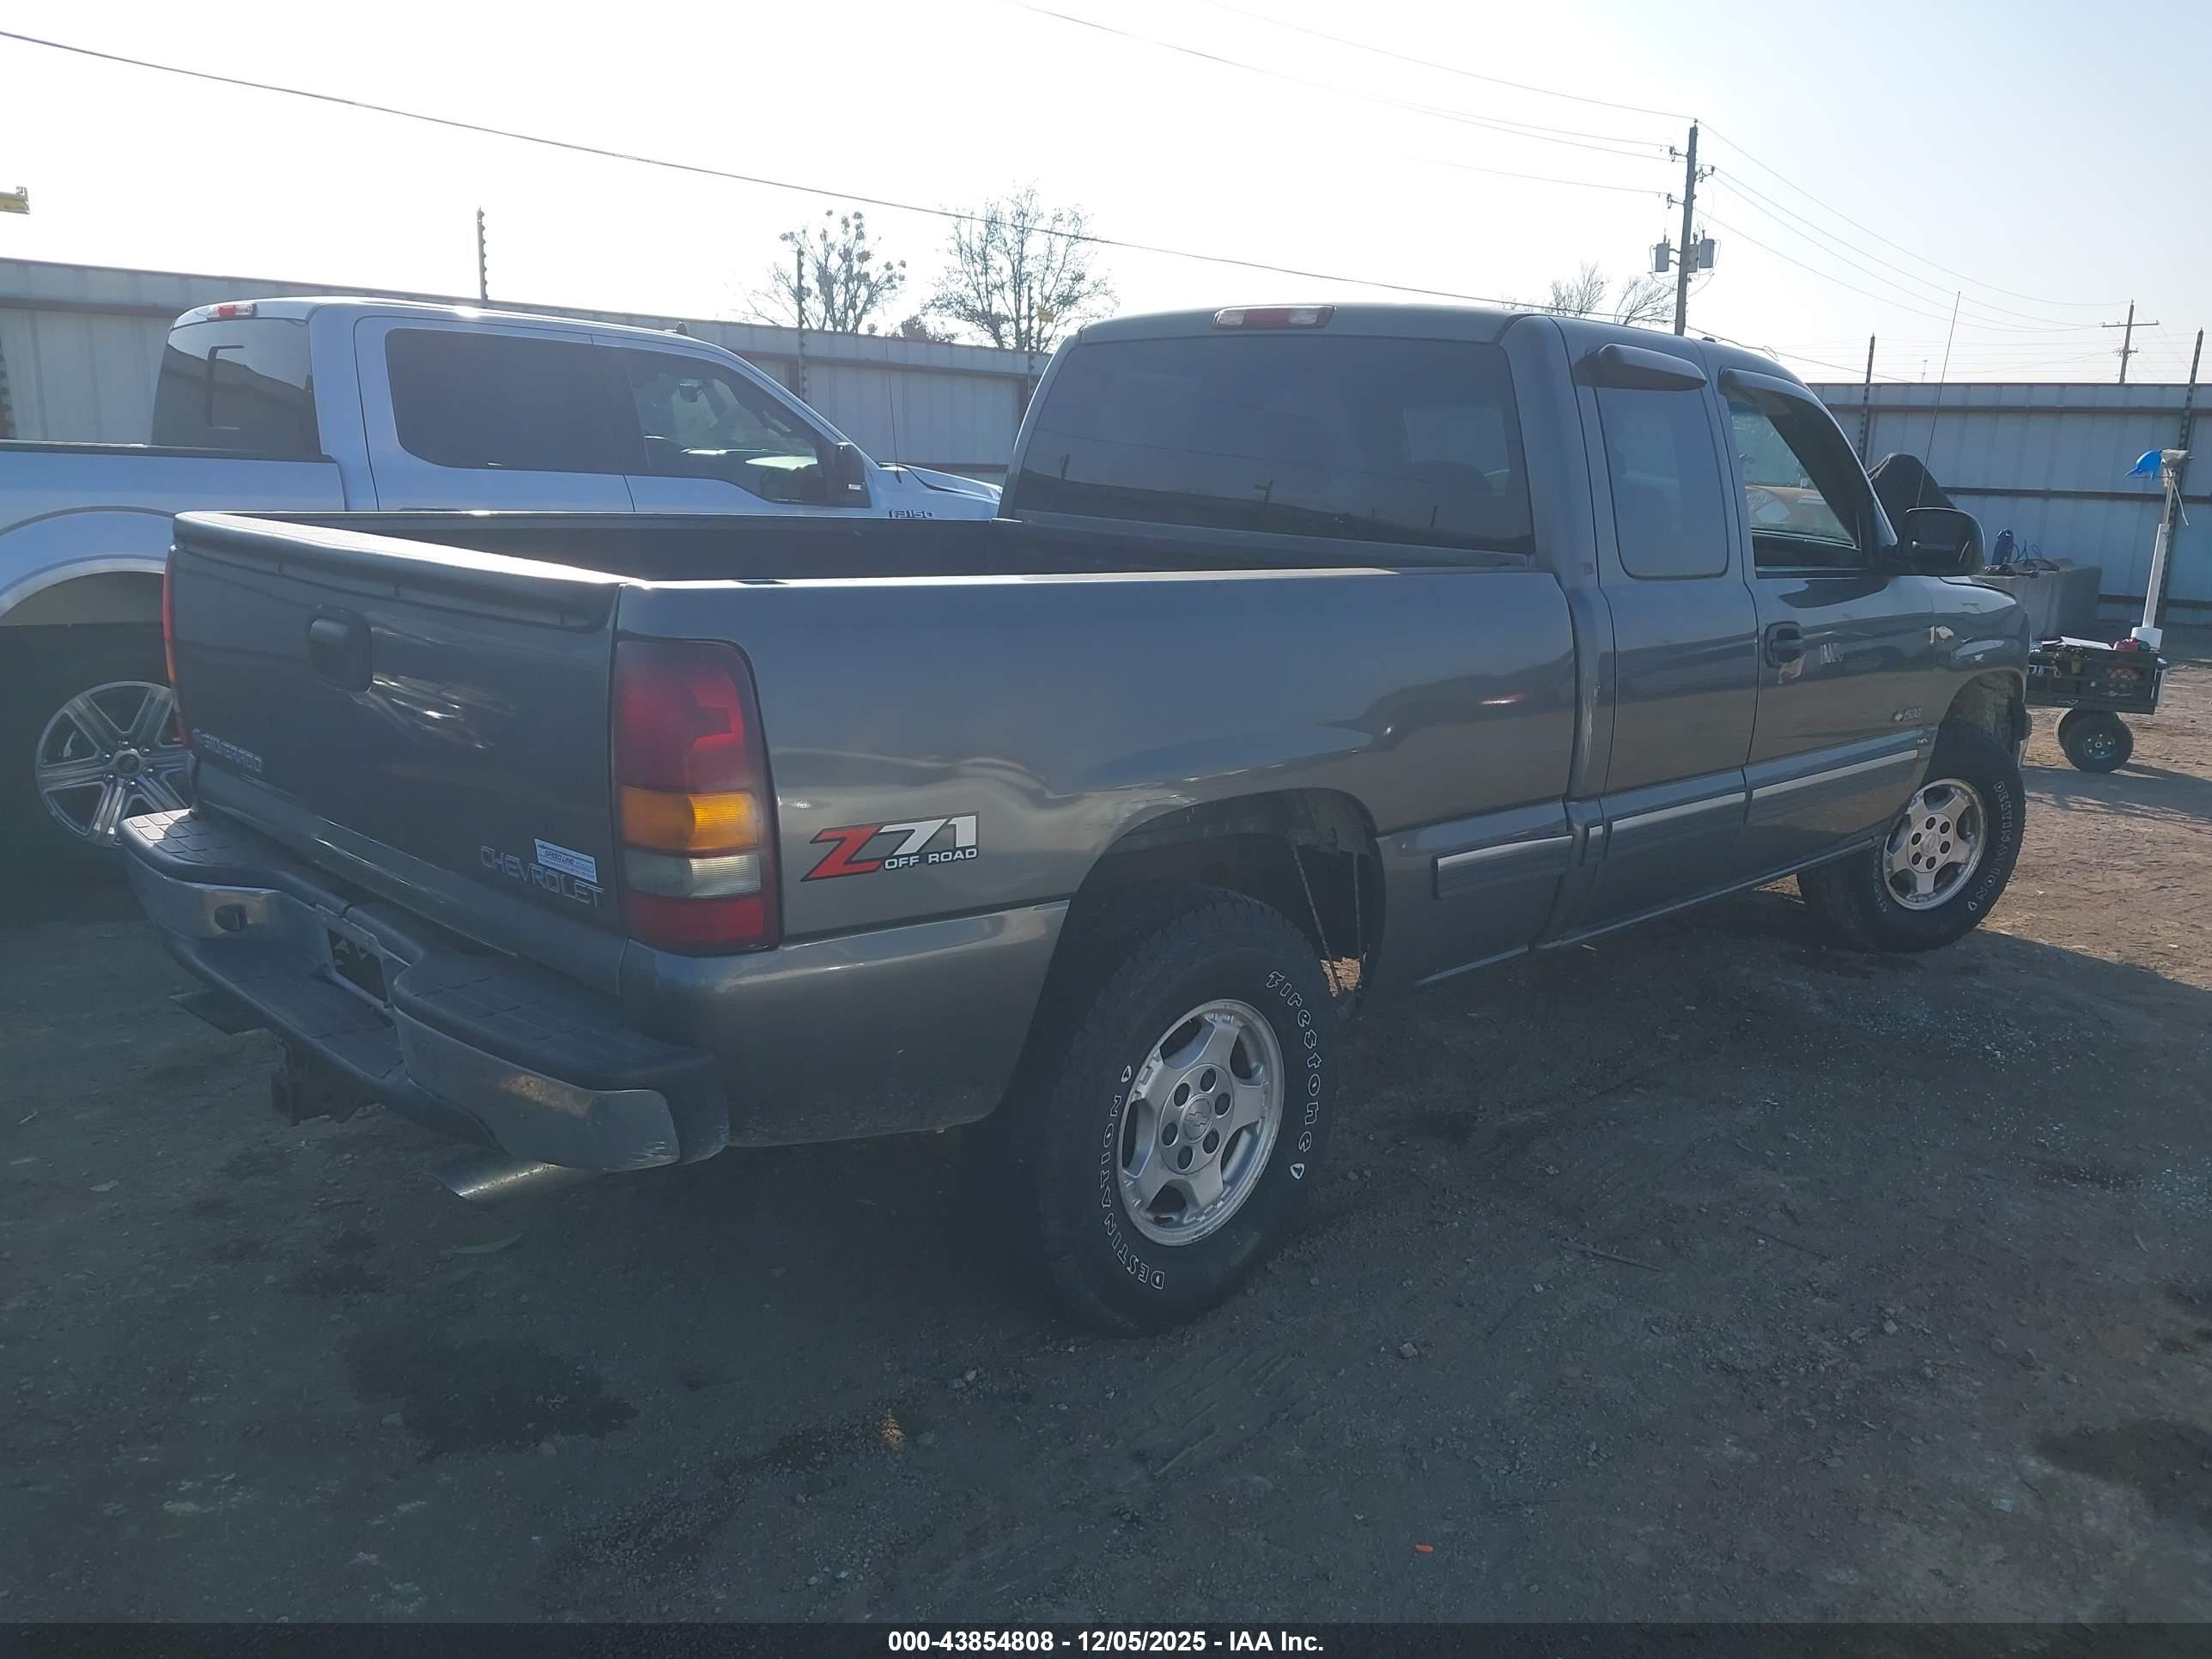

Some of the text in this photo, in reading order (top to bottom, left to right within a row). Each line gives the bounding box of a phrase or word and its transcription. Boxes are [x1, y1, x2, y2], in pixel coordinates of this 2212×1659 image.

[480, 845, 605, 908] CHEVROLET
[800, 811, 979, 883] Z71
[884, 847, 978, 870] OFF ROAD
[1266, 971, 1322, 1153] Firestone
